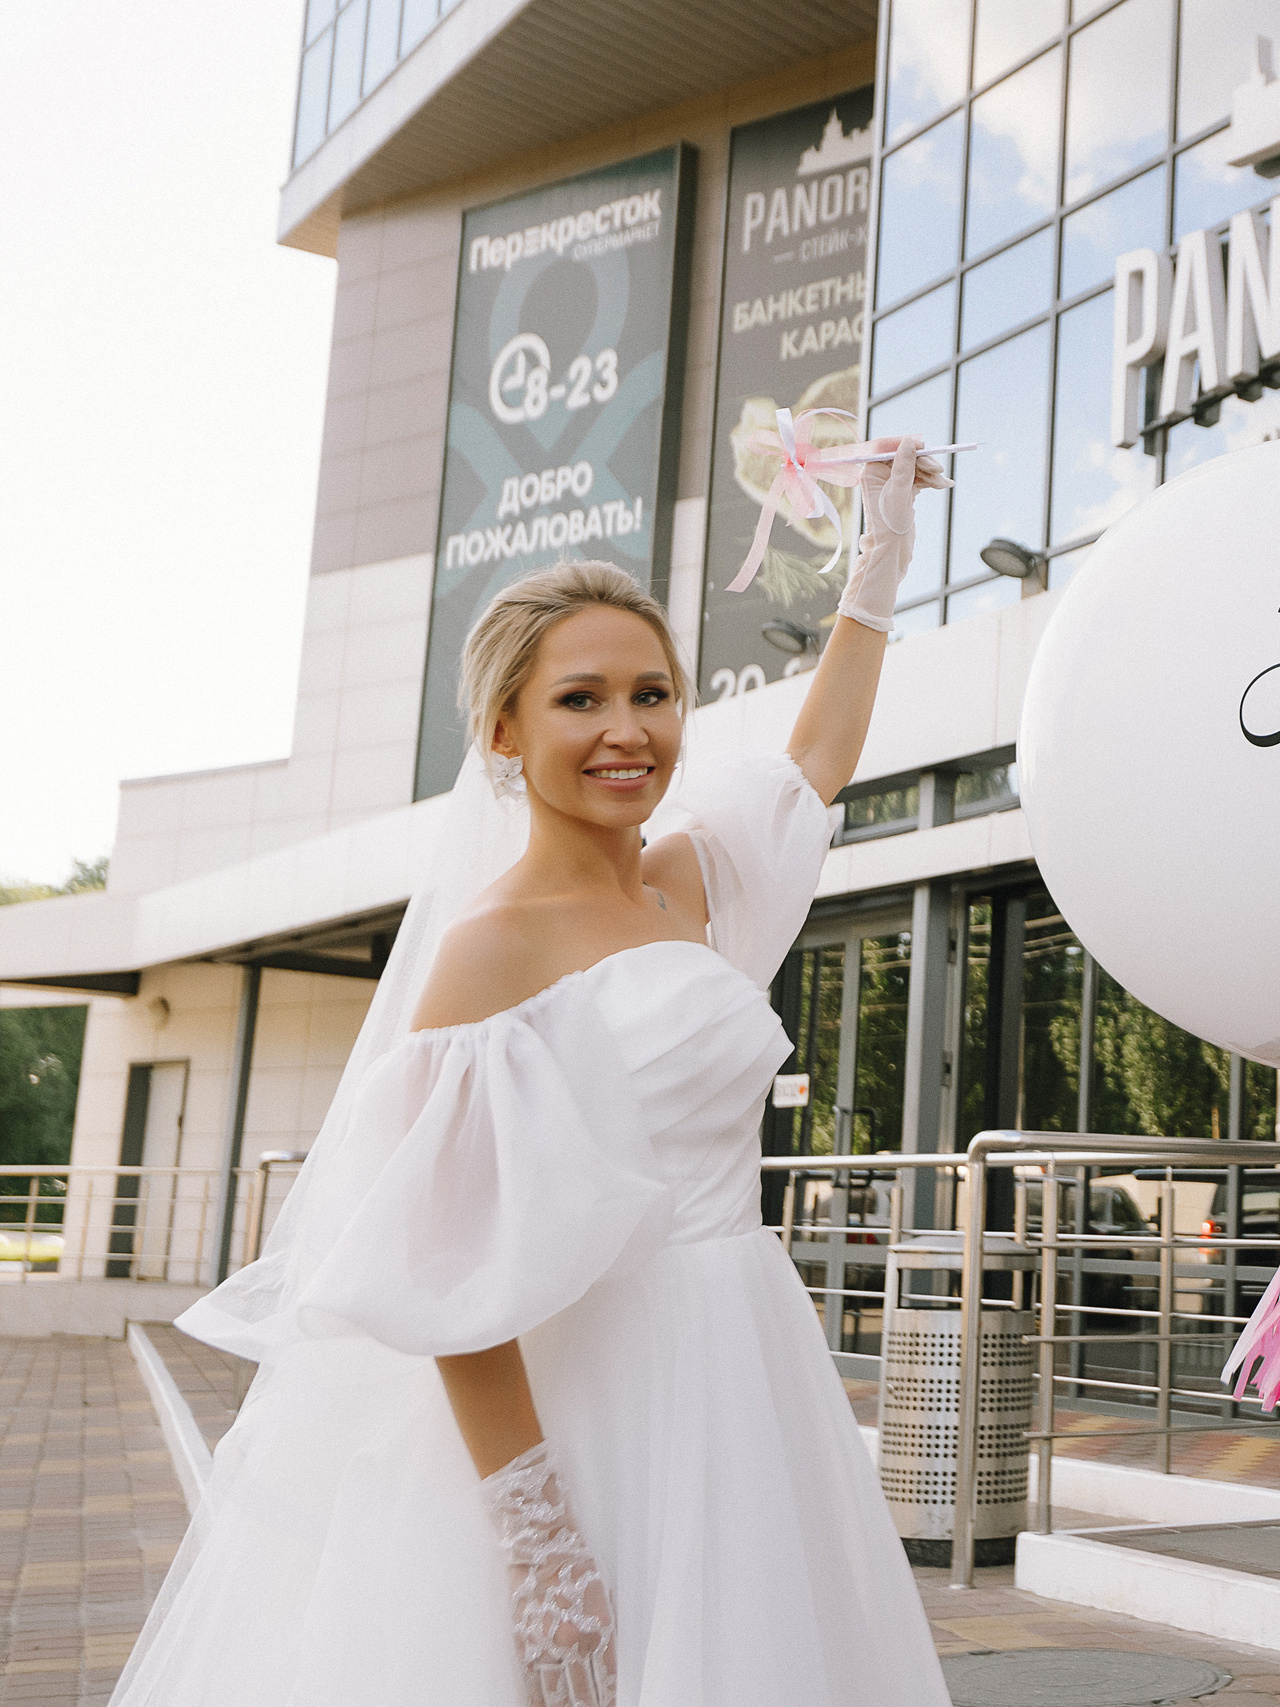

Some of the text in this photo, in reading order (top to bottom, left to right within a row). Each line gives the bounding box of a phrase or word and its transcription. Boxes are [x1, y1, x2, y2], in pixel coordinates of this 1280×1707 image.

[743, 165, 870, 254] PANOR
[521, 347, 619, 421] 8-23
[496, 460, 594, 520] ДОБРО
[445, 495, 644, 570] ПОЖАЛОВАТЬ!
